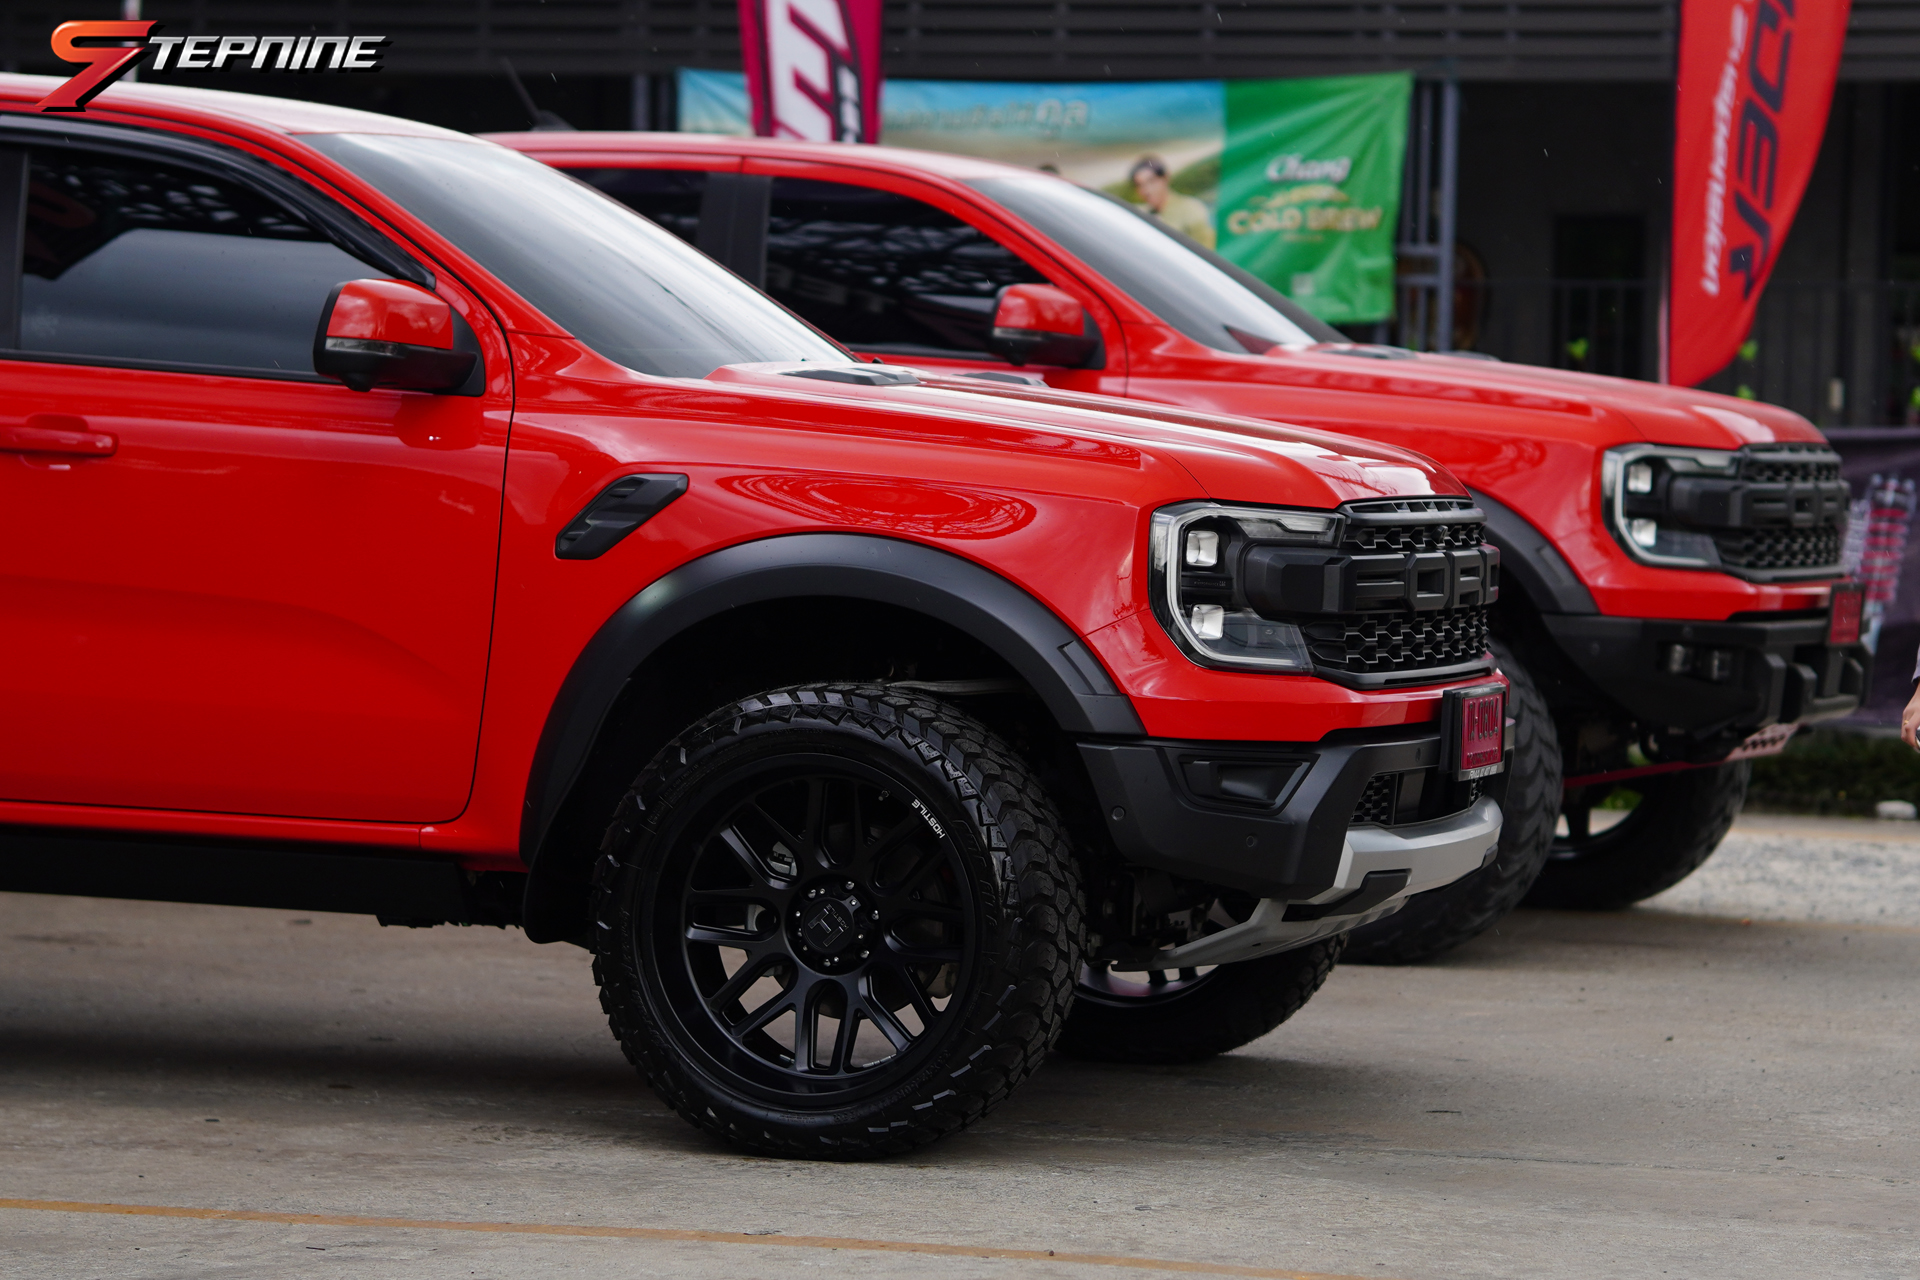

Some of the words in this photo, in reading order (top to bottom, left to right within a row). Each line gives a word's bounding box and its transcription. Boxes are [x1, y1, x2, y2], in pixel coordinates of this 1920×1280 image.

[1343, 543, 1500, 613] FORD
[911, 798, 946, 839] HOSTILE
[825, 903, 850, 931] HOSTILE
